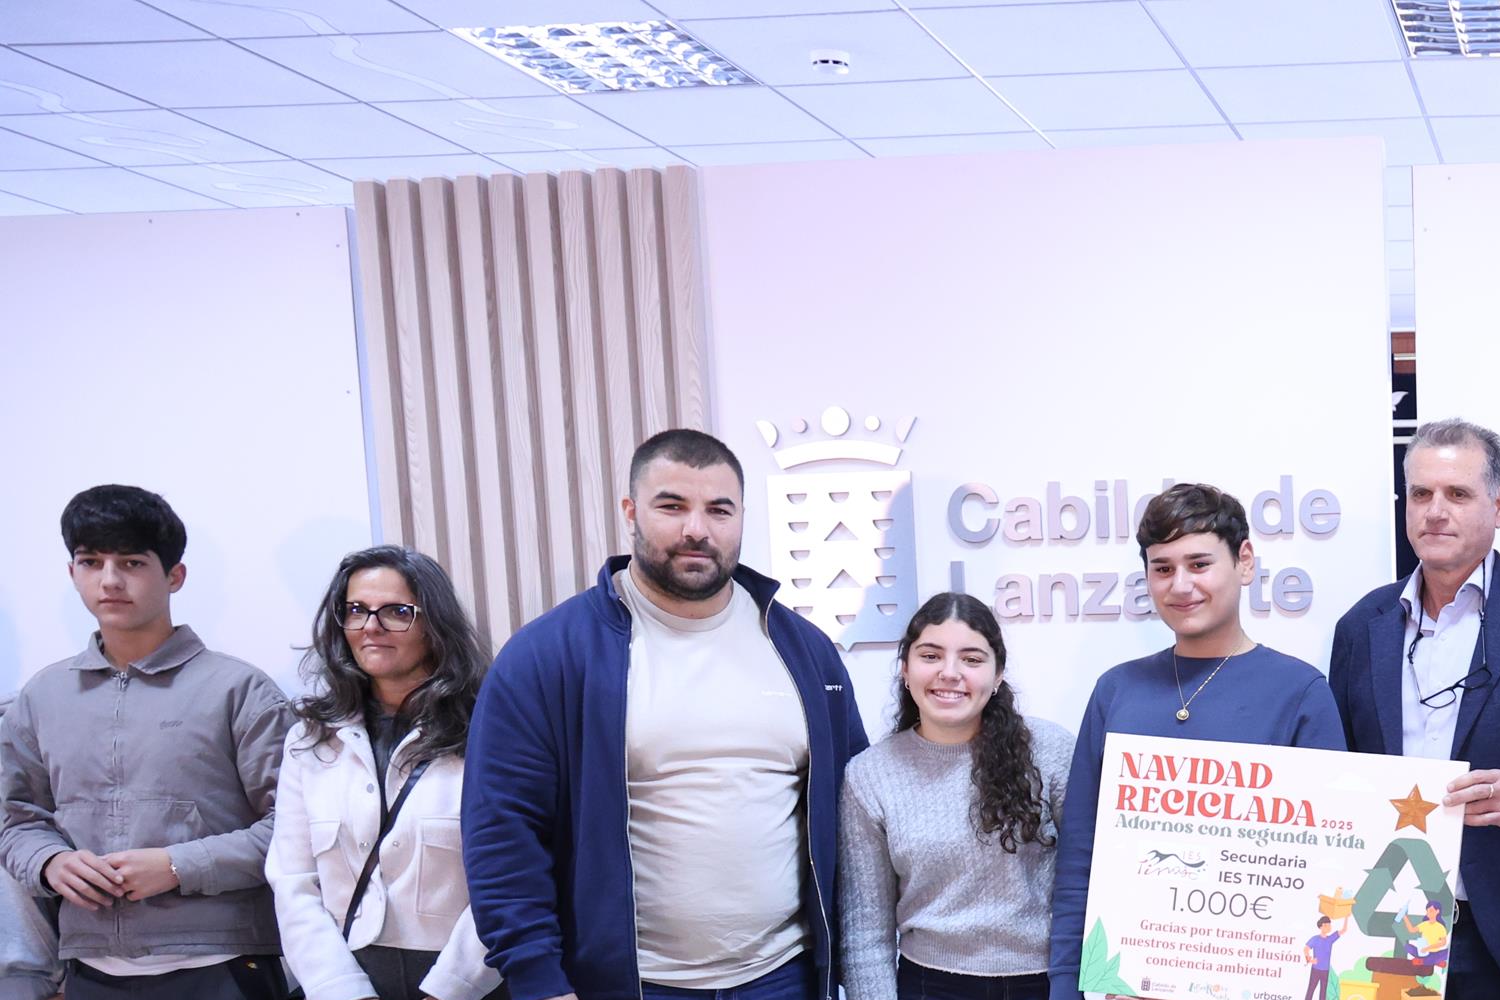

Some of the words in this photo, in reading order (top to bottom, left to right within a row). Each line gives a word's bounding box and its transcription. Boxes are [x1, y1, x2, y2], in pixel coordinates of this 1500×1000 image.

[947, 477, 1178, 543] Cabil
[1250, 474, 1342, 537] de
[1119, 752, 1273, 789] NAVIDAD
[1115, 784, 1317, 827] RECICLADA
[1321, 819, 1353, 830] 2025
[1115, 813, 1194, 834] Adornos
[1198, 824, 1232, 838] con
[1237, 826, 1318, 848] segunda
[1325, 832, 1365, 850] vida
[1220, 850, 1307, 868] Secundaria
[1218, 871, 1242, 884] IES
[1247, 873, 1305, 890] TINAJO
[1169, 886, 1275, 920] 1.000€
[1140, 919, 1187, 934] Gracias
[1190, 927, 1213, 938] por
[1216, 927, 1296, 945] transformar
[1120, 935, 1176, 951] nuestros
[1179, 942, 1234, 957] residuos
[1237, 949, 1253, 959] en
[1256, 949, 1301, 963] ilusión
[1145, 955, 1213, 971] conciencia
[1216, 965, 1282, 978] ambiental
